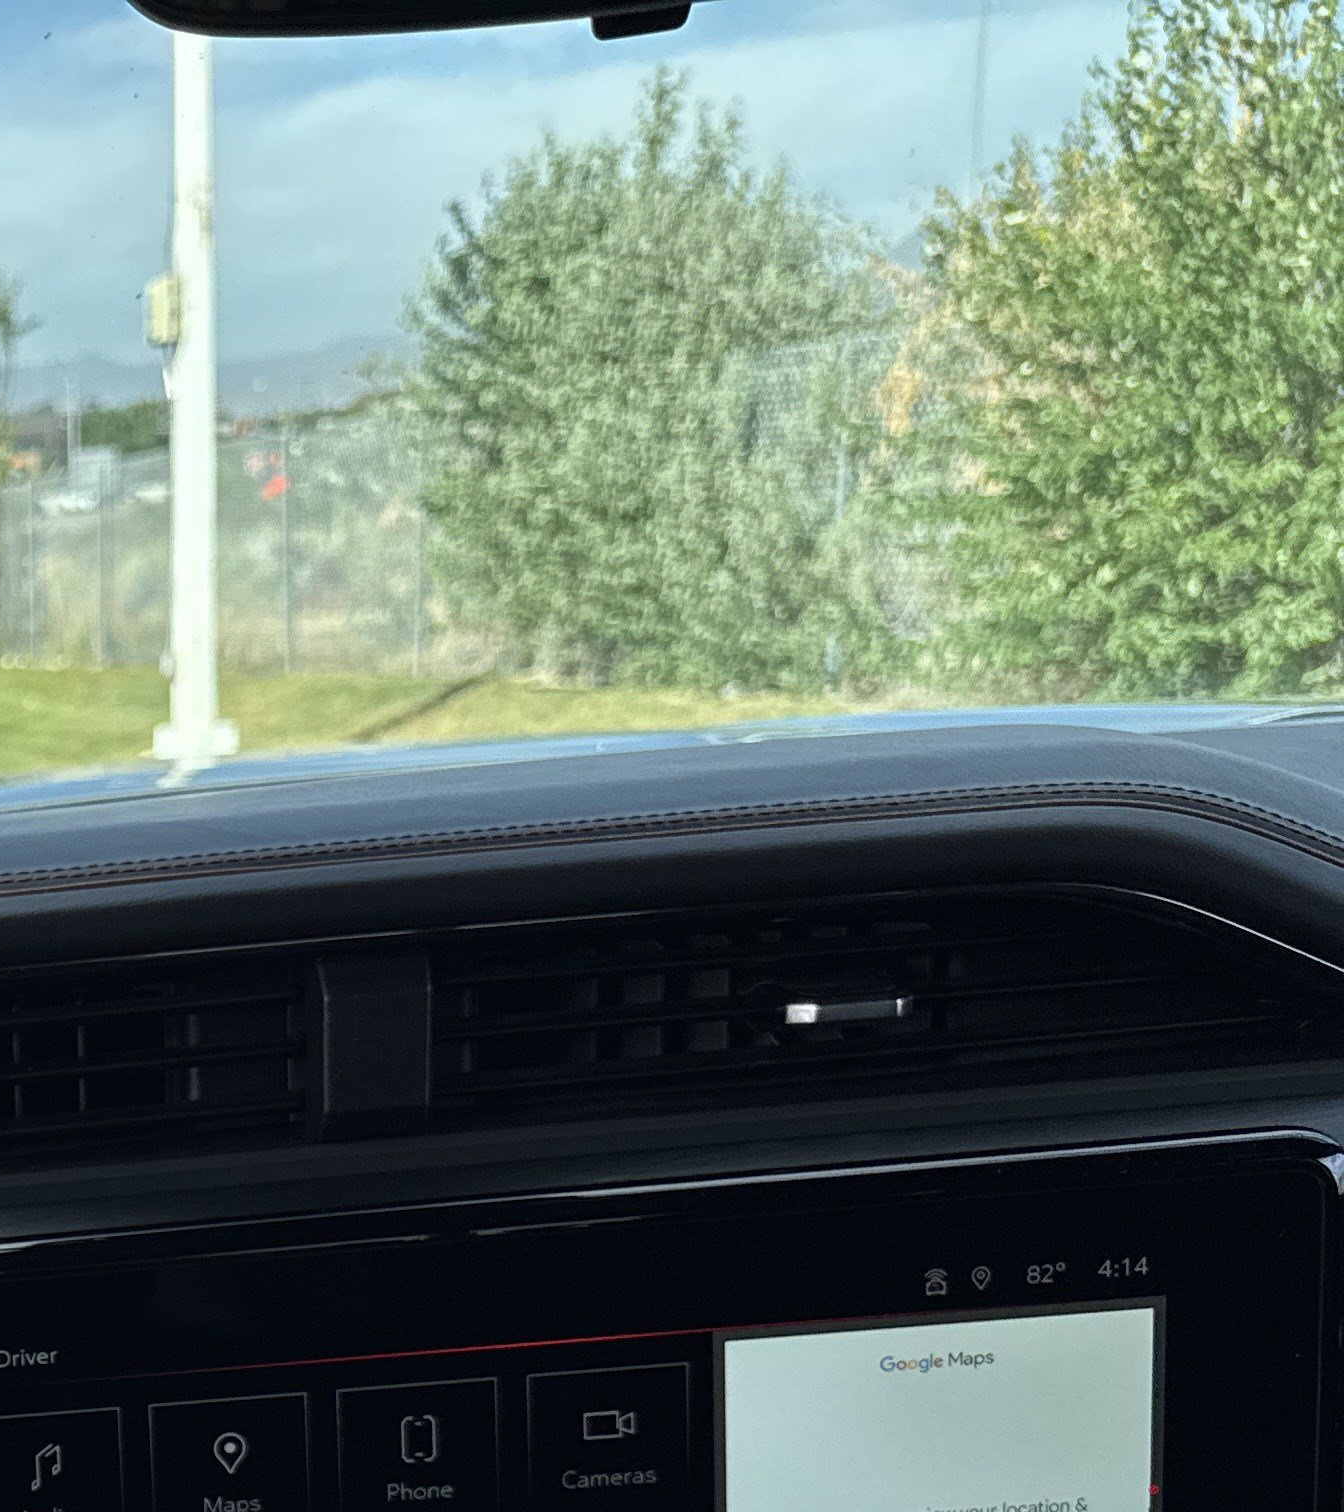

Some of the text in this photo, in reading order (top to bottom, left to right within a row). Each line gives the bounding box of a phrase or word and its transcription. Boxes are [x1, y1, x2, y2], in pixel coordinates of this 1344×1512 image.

[1026, 1262, 1067, 1285] 82°
[1097, 1256, 1150, 1279] 4:14
[879, 1351, 995, 1374] Google Maps
[562, 1467, 658, 1490] Cameras
[387, 1481, 455, 1503] Phone
[1074, 1497, 1089, 1512] &
